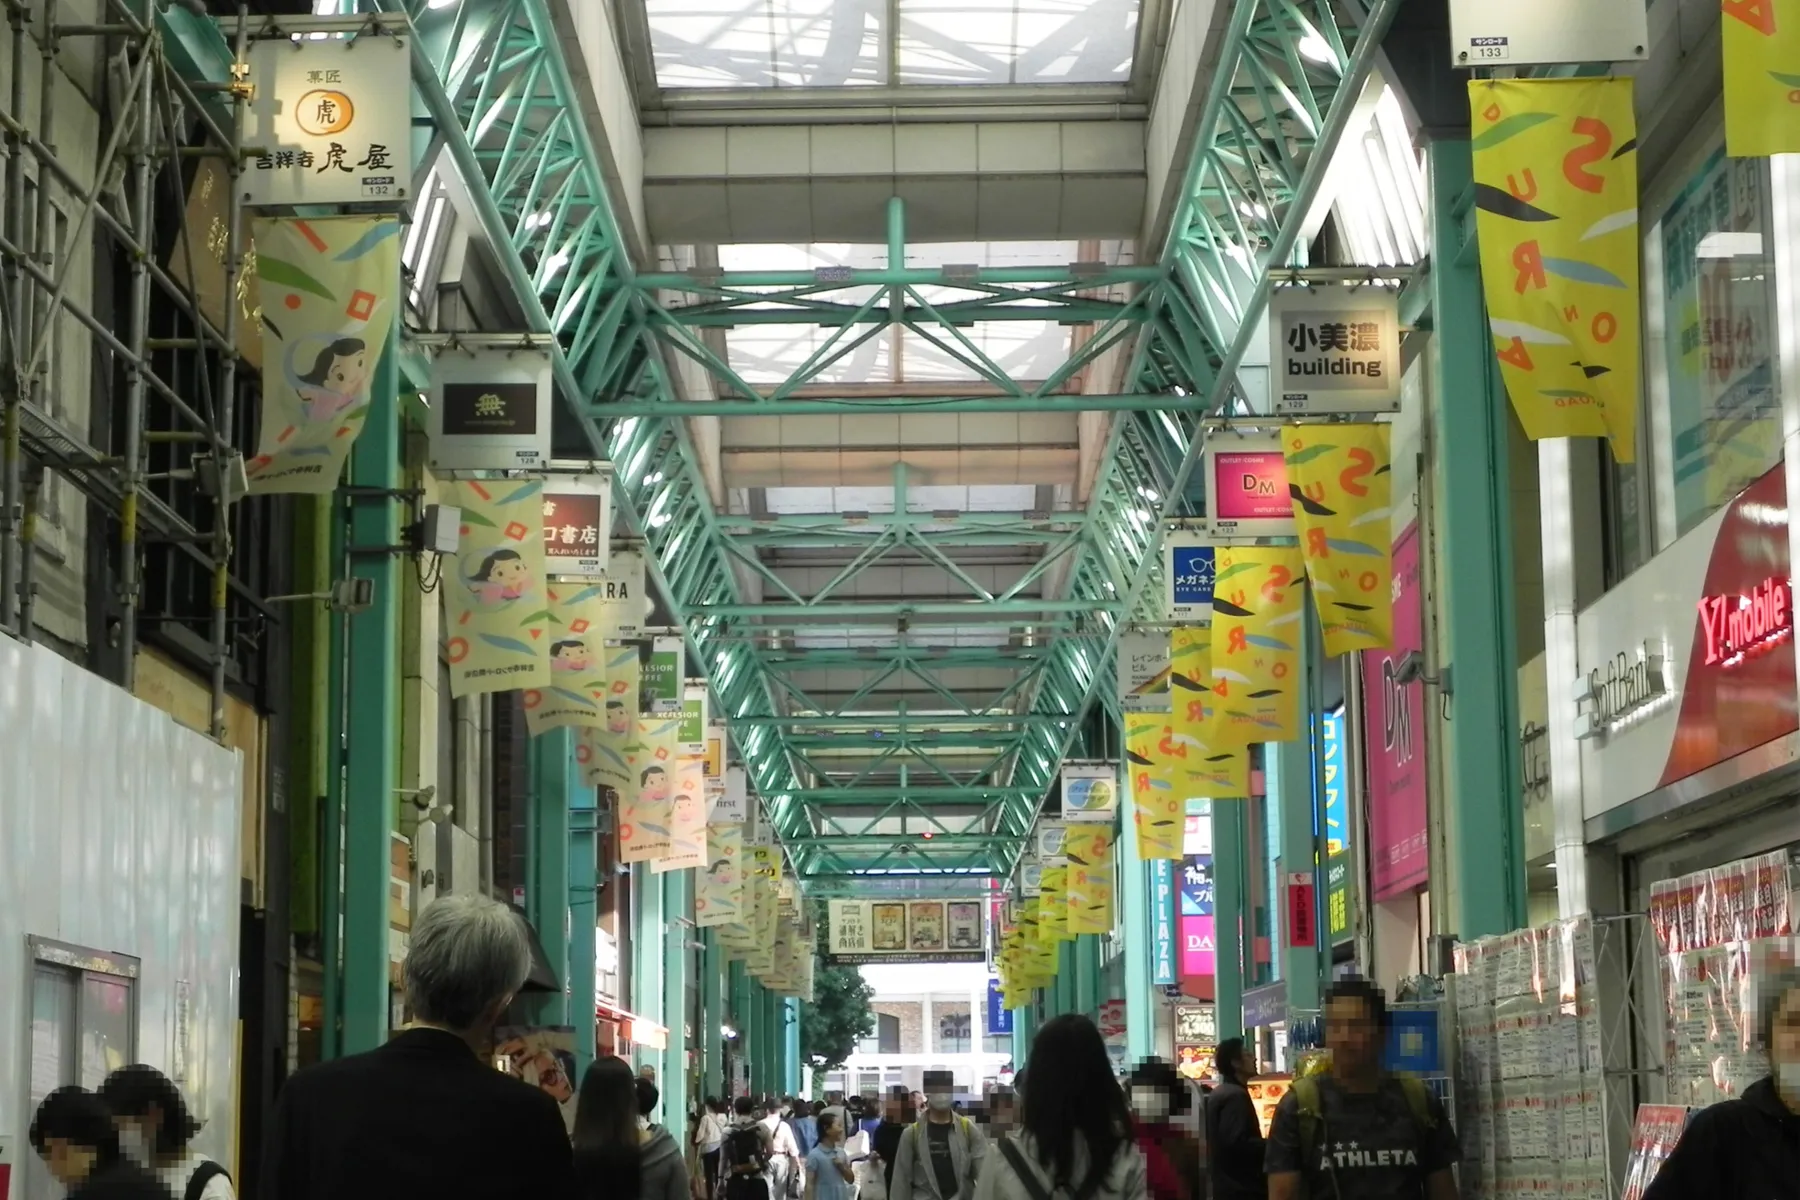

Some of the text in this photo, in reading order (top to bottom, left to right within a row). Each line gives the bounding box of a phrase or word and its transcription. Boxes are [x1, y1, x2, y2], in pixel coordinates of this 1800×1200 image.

[1479, 47, 1502, 57] 133
[316, 99, 337, 125] 虎
[255, 142, 394, 174] 吉祥寺 虎屋
[368, 186, 389, 195] 132
[1287, 323, 1380, 353] 小美濃
[1287, 358, 1382, 378] building
[1696, 577, 1784, 666] Y!mobile
[1131, 664, 1148, 672] ビル
[1591, 638, 1654, 728] SoftBank
[715, 798, 736, 808] first
[1320, 1149, 1417, 1171] ATHLETA
